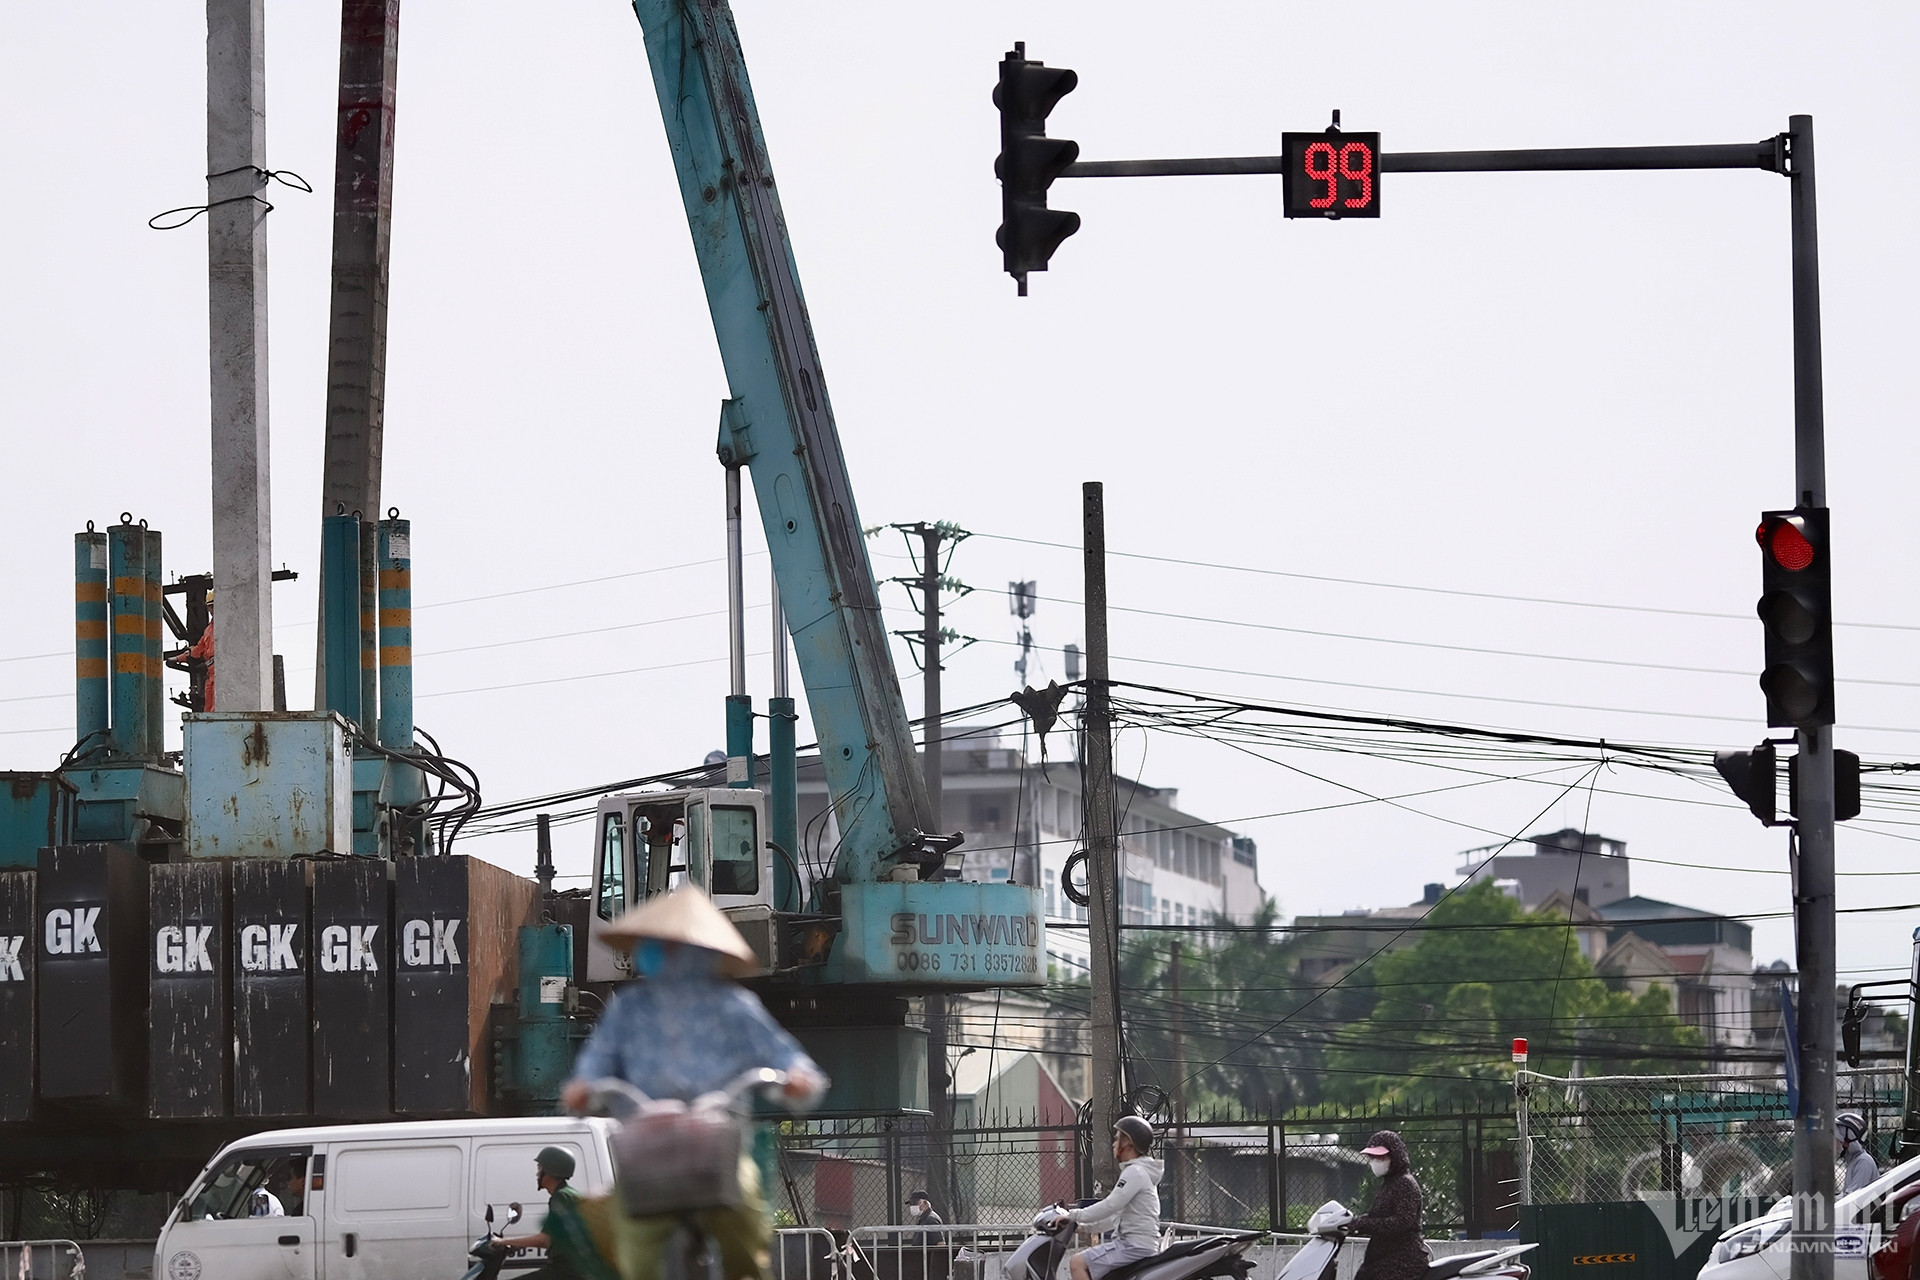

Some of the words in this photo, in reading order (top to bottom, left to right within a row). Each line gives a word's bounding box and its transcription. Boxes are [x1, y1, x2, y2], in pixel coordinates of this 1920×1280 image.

[1304, 142, 1372, 208] 99
[45, 907, 102, 955] GK
[156, 925, 214, 973] GK
[241, 924, 299, 971] GK
[321, 925, 379, 973] GK
[403, 919, 462, 967] GK
[890, 912, 1039, 947] SUNWARD
[897, 951, 941, 973] 0086
[950, 953, 976, 972] 731
